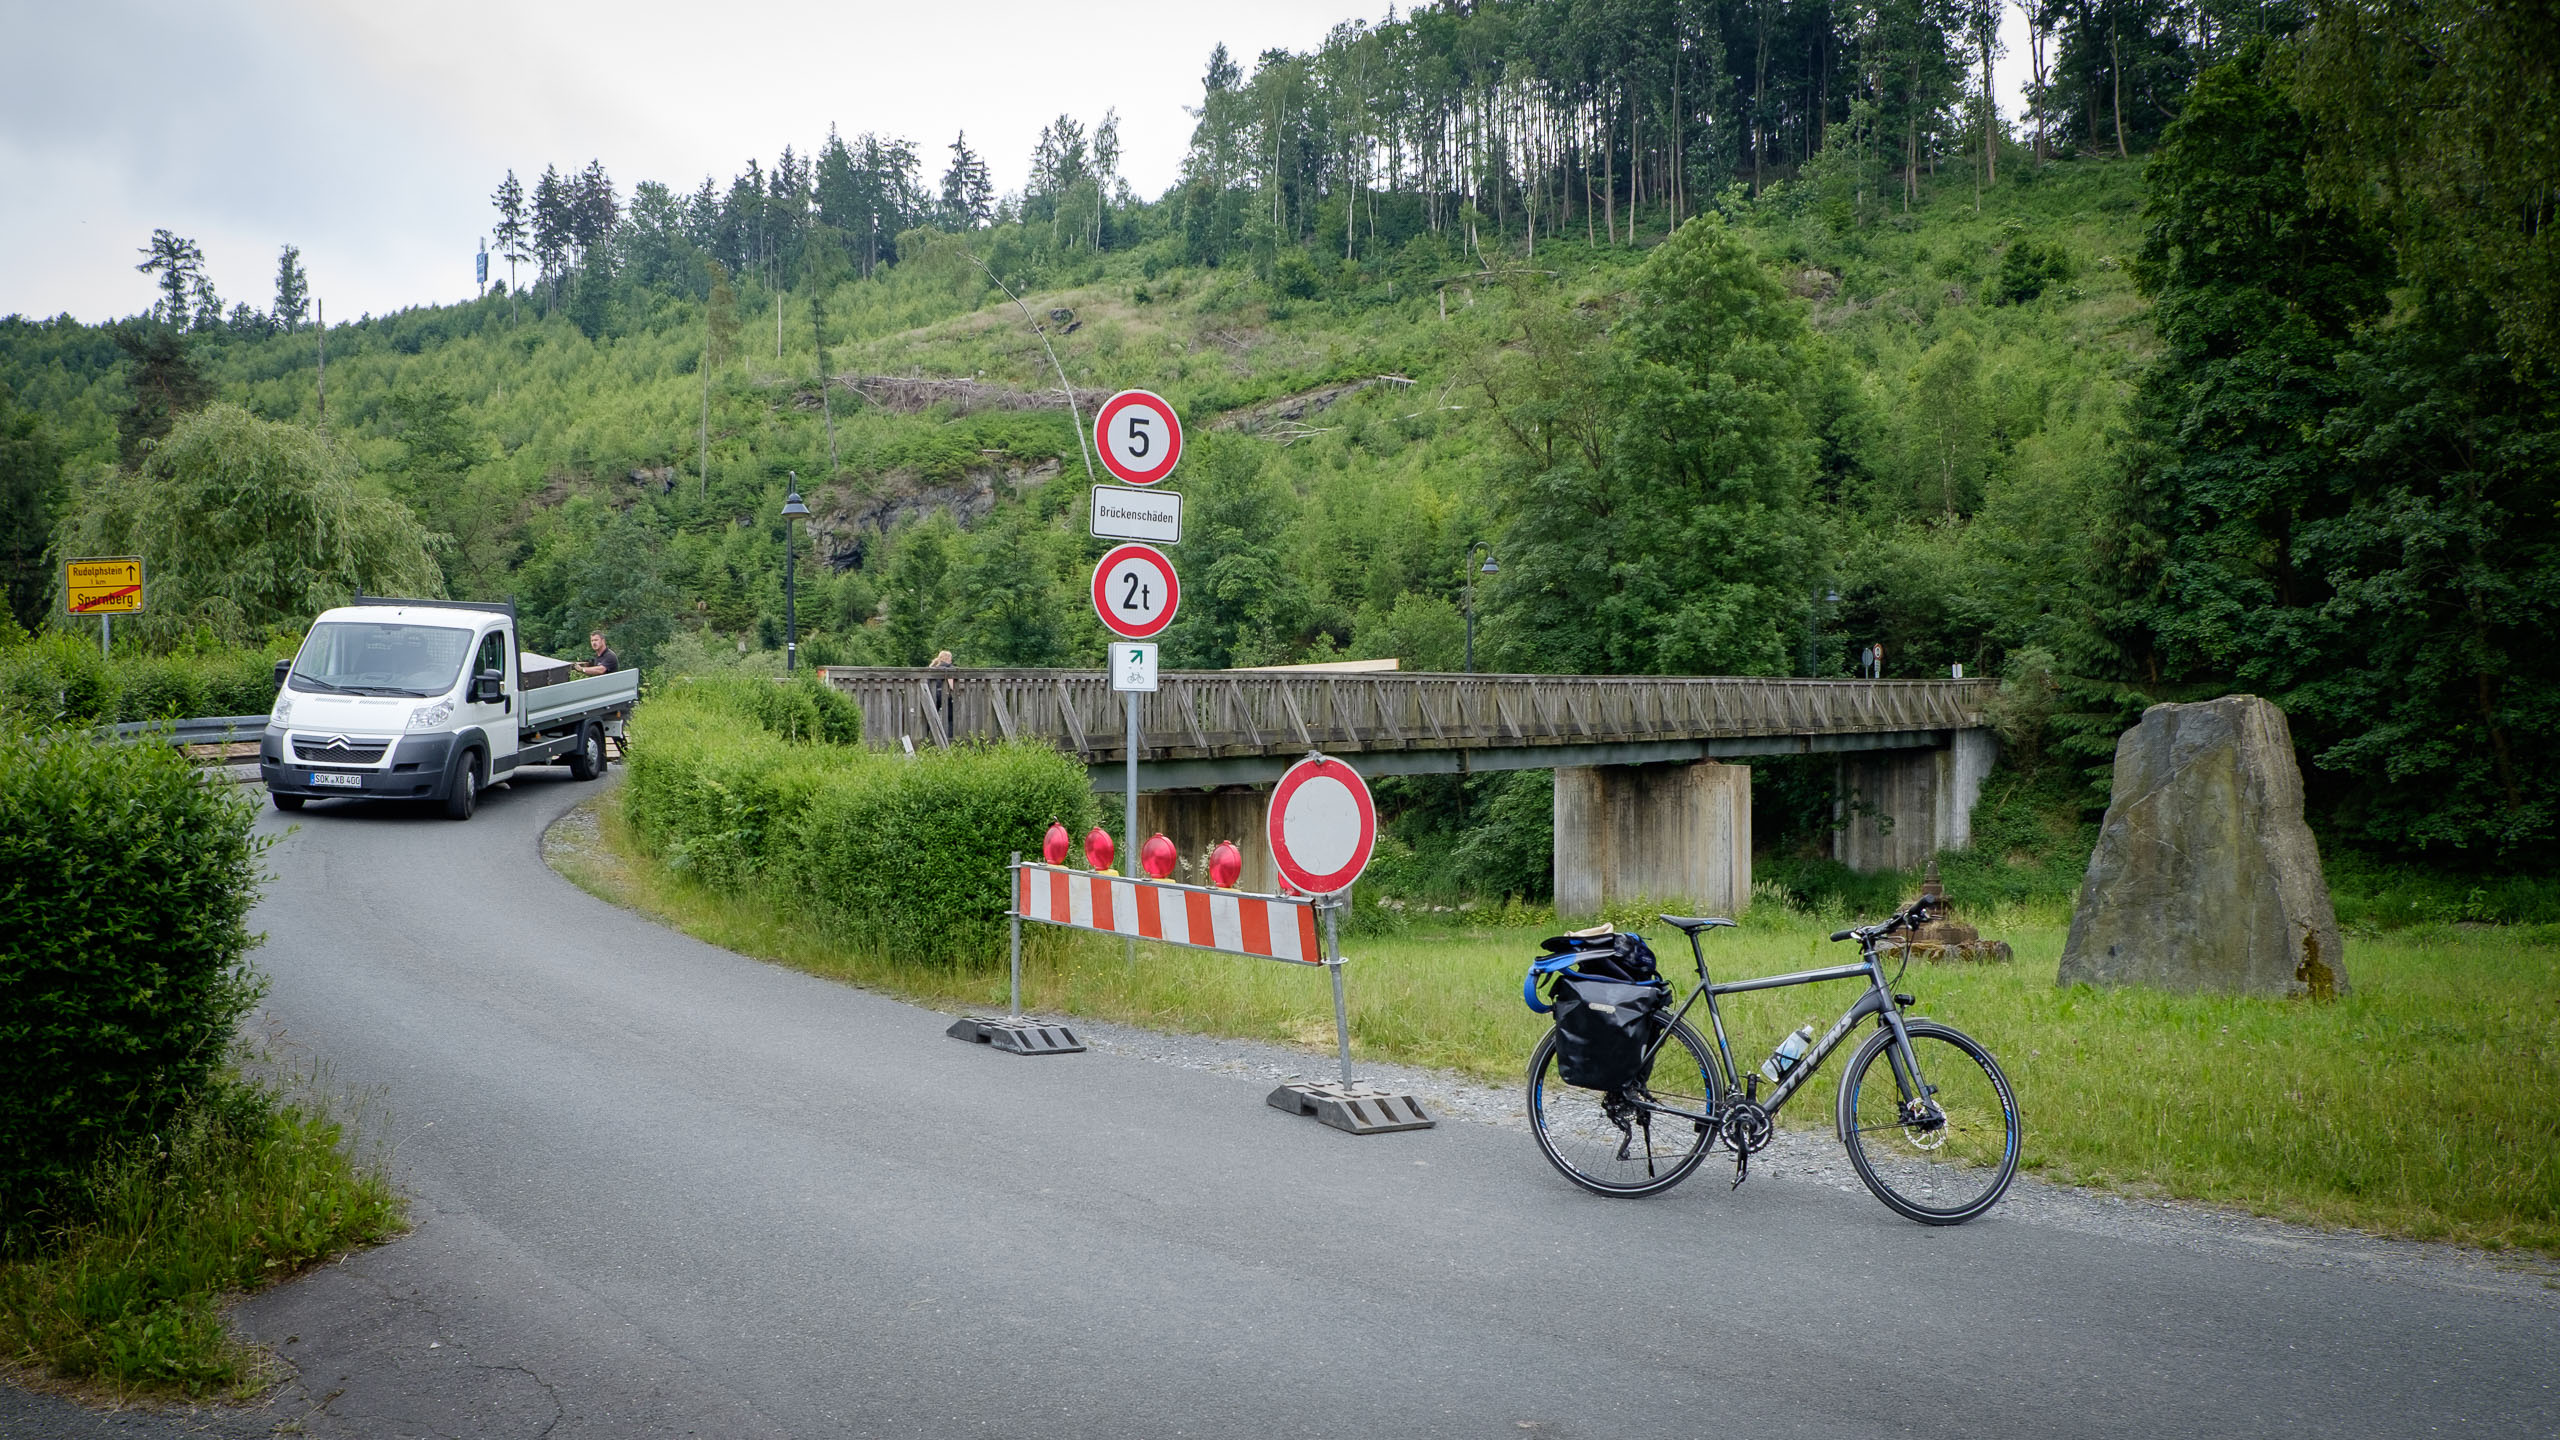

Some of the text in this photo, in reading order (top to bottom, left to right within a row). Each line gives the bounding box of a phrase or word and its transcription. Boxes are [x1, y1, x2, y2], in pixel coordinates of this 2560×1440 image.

[1128, 418, 1149, 457] 5
[1100, 505, 1173, 524] Brückenschäden
[73, 567, 122, 577] Rudolphstein
[77, 593, 133, 607] Sparnberg
[315, 775, 329, 783] SOK
[335, 776, 345, 784] XB
[1774, 1012, 1852, 1101] STEVENS
